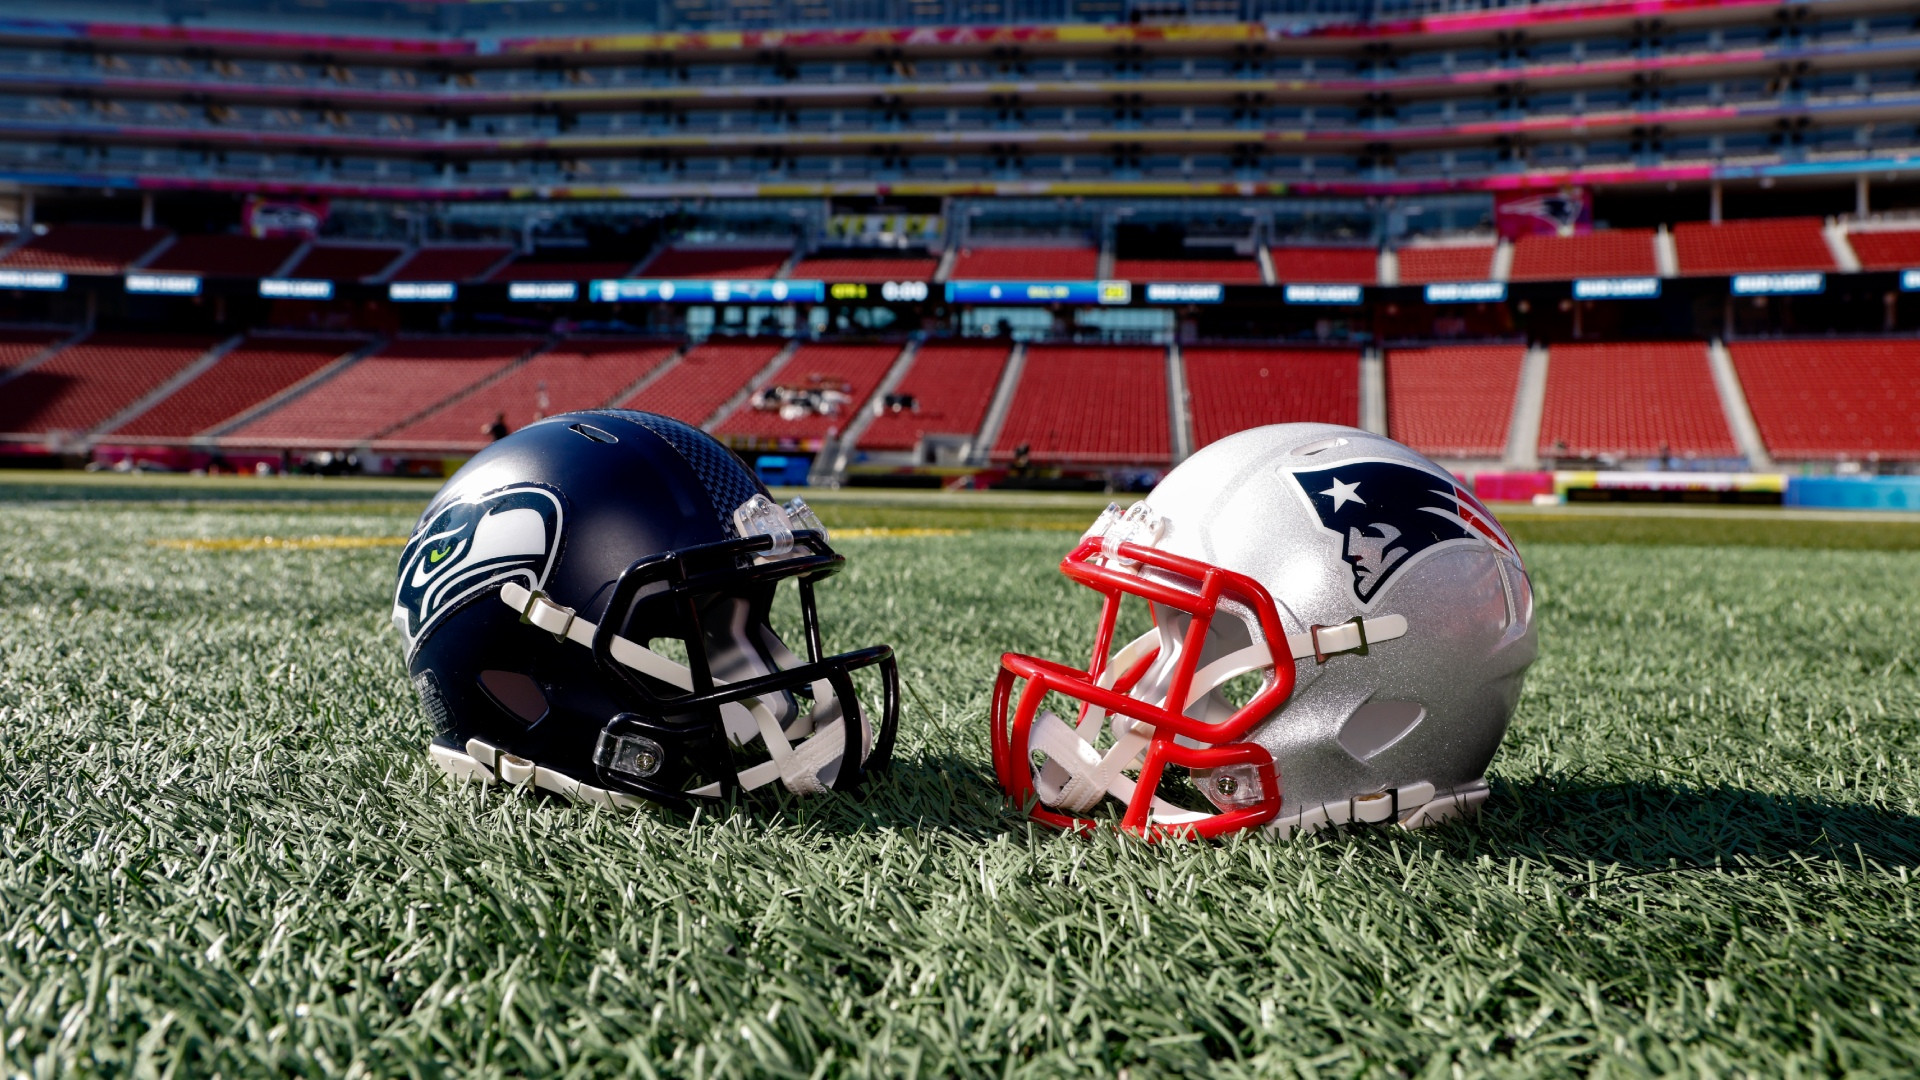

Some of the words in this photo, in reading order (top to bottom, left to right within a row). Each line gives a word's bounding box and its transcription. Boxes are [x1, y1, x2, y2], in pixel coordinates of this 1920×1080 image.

[1427, 284, 1458, 300] BUD
[1459, 283, 1503, 299] LIGHT
[1576, 280, 1610, 297] BUD
[1611, 279, 1657, 295] LIGHT
[1734, 275, 1769, 292] BUD
[1770, 274, 1821, 291] LIGHT
[1148, 284, 1178, 300] BUD
[1179, 284, 1220, 300] LIGHT
[1287, 285, 1317, 301] BUD
[1318, 285, 1360, 301] LIGHT
